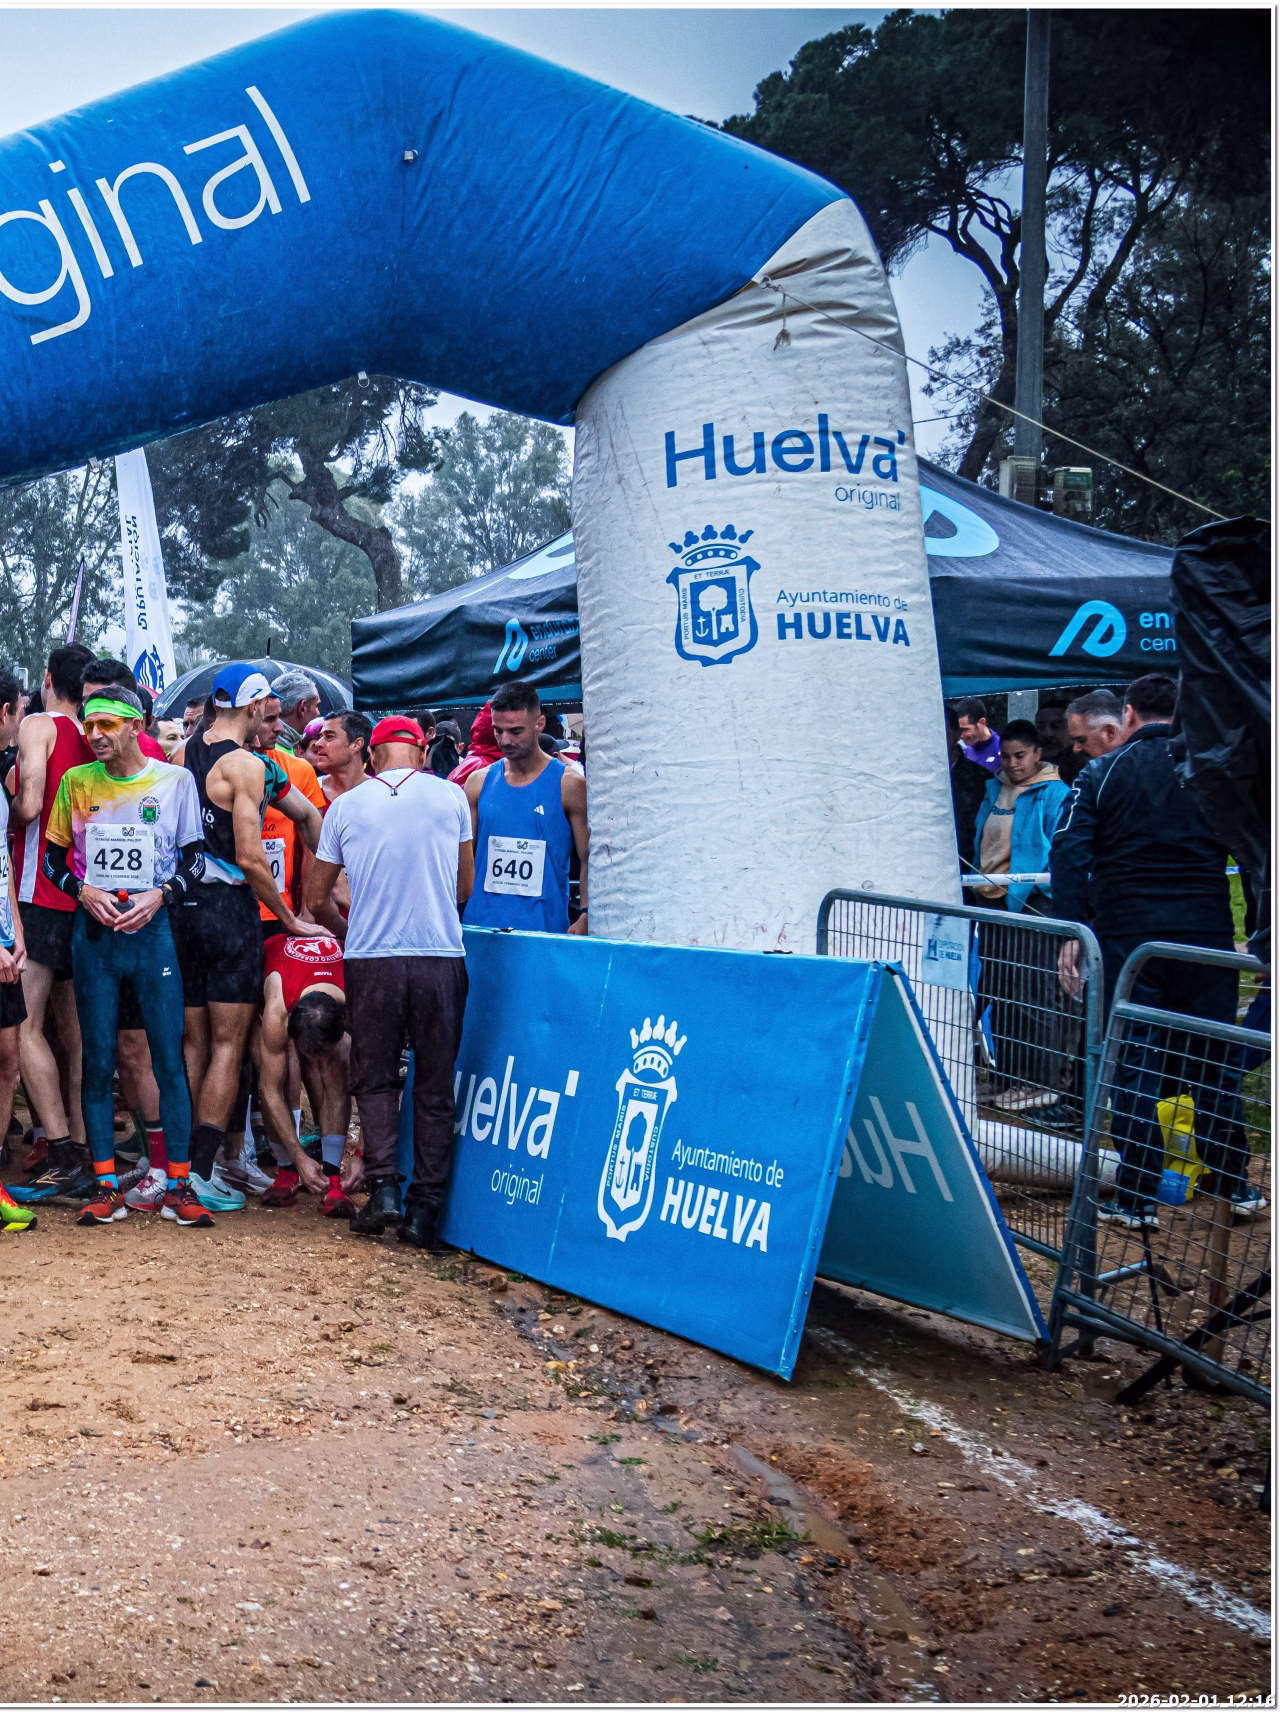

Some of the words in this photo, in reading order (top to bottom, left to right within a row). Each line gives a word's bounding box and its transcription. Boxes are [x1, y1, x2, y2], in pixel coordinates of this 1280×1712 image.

[835, 484, 900, 511] original
[738, 588, 747, 623] CUSTODIA
[777, 589, 891, 608] Ayuntamiento
[894, 596, 908, 611] de
[776, 611, 911, 647] HUELVA
[1140, 638, 1176, 651] cen
[528, 645, 558, 663] center
[93, 848, 142, 871] 428
[492, 857, 533, 880] 640
[453, 1055, 580, 1160] uelva
[606, 1143, 618, 1187] PORTUS
[644, 1126, 659, 1181] CUSTODIA
[671, 1138, 763, 1183] Ayuntamiento
[765, 1159, 784, 1188] de
[491, 1163, 544, 1205] original
[660, 1176, 771, 1253] HUELVA
